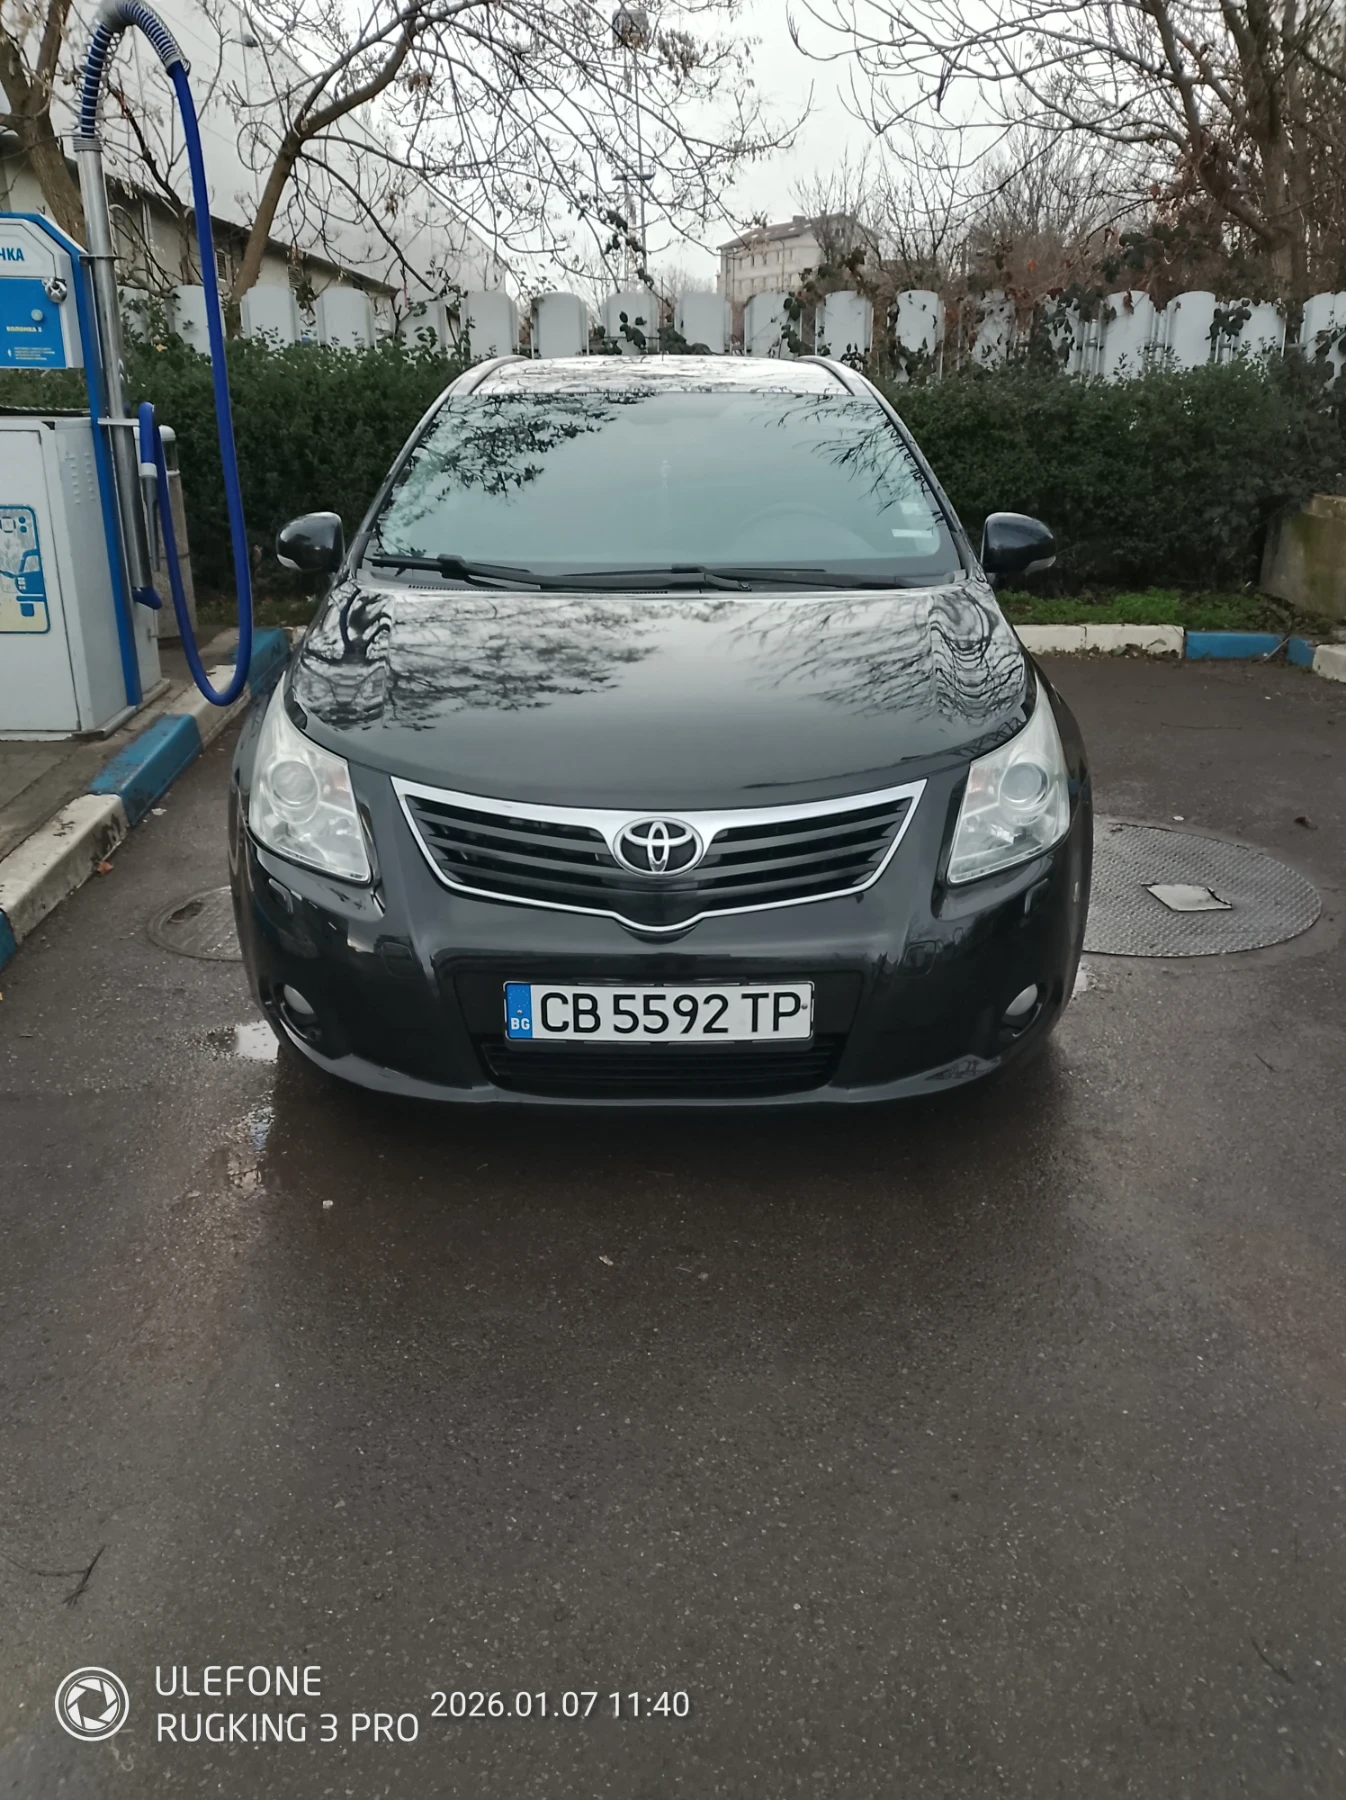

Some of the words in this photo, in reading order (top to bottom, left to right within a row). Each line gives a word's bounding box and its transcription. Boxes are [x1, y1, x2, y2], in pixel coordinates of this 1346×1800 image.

[510, 1017, 530, 1030] BG
[540, 992, 601, 1034] CB
[613, 993, 729, 1035] 5592
[741, 991, 802, 1033] TP
